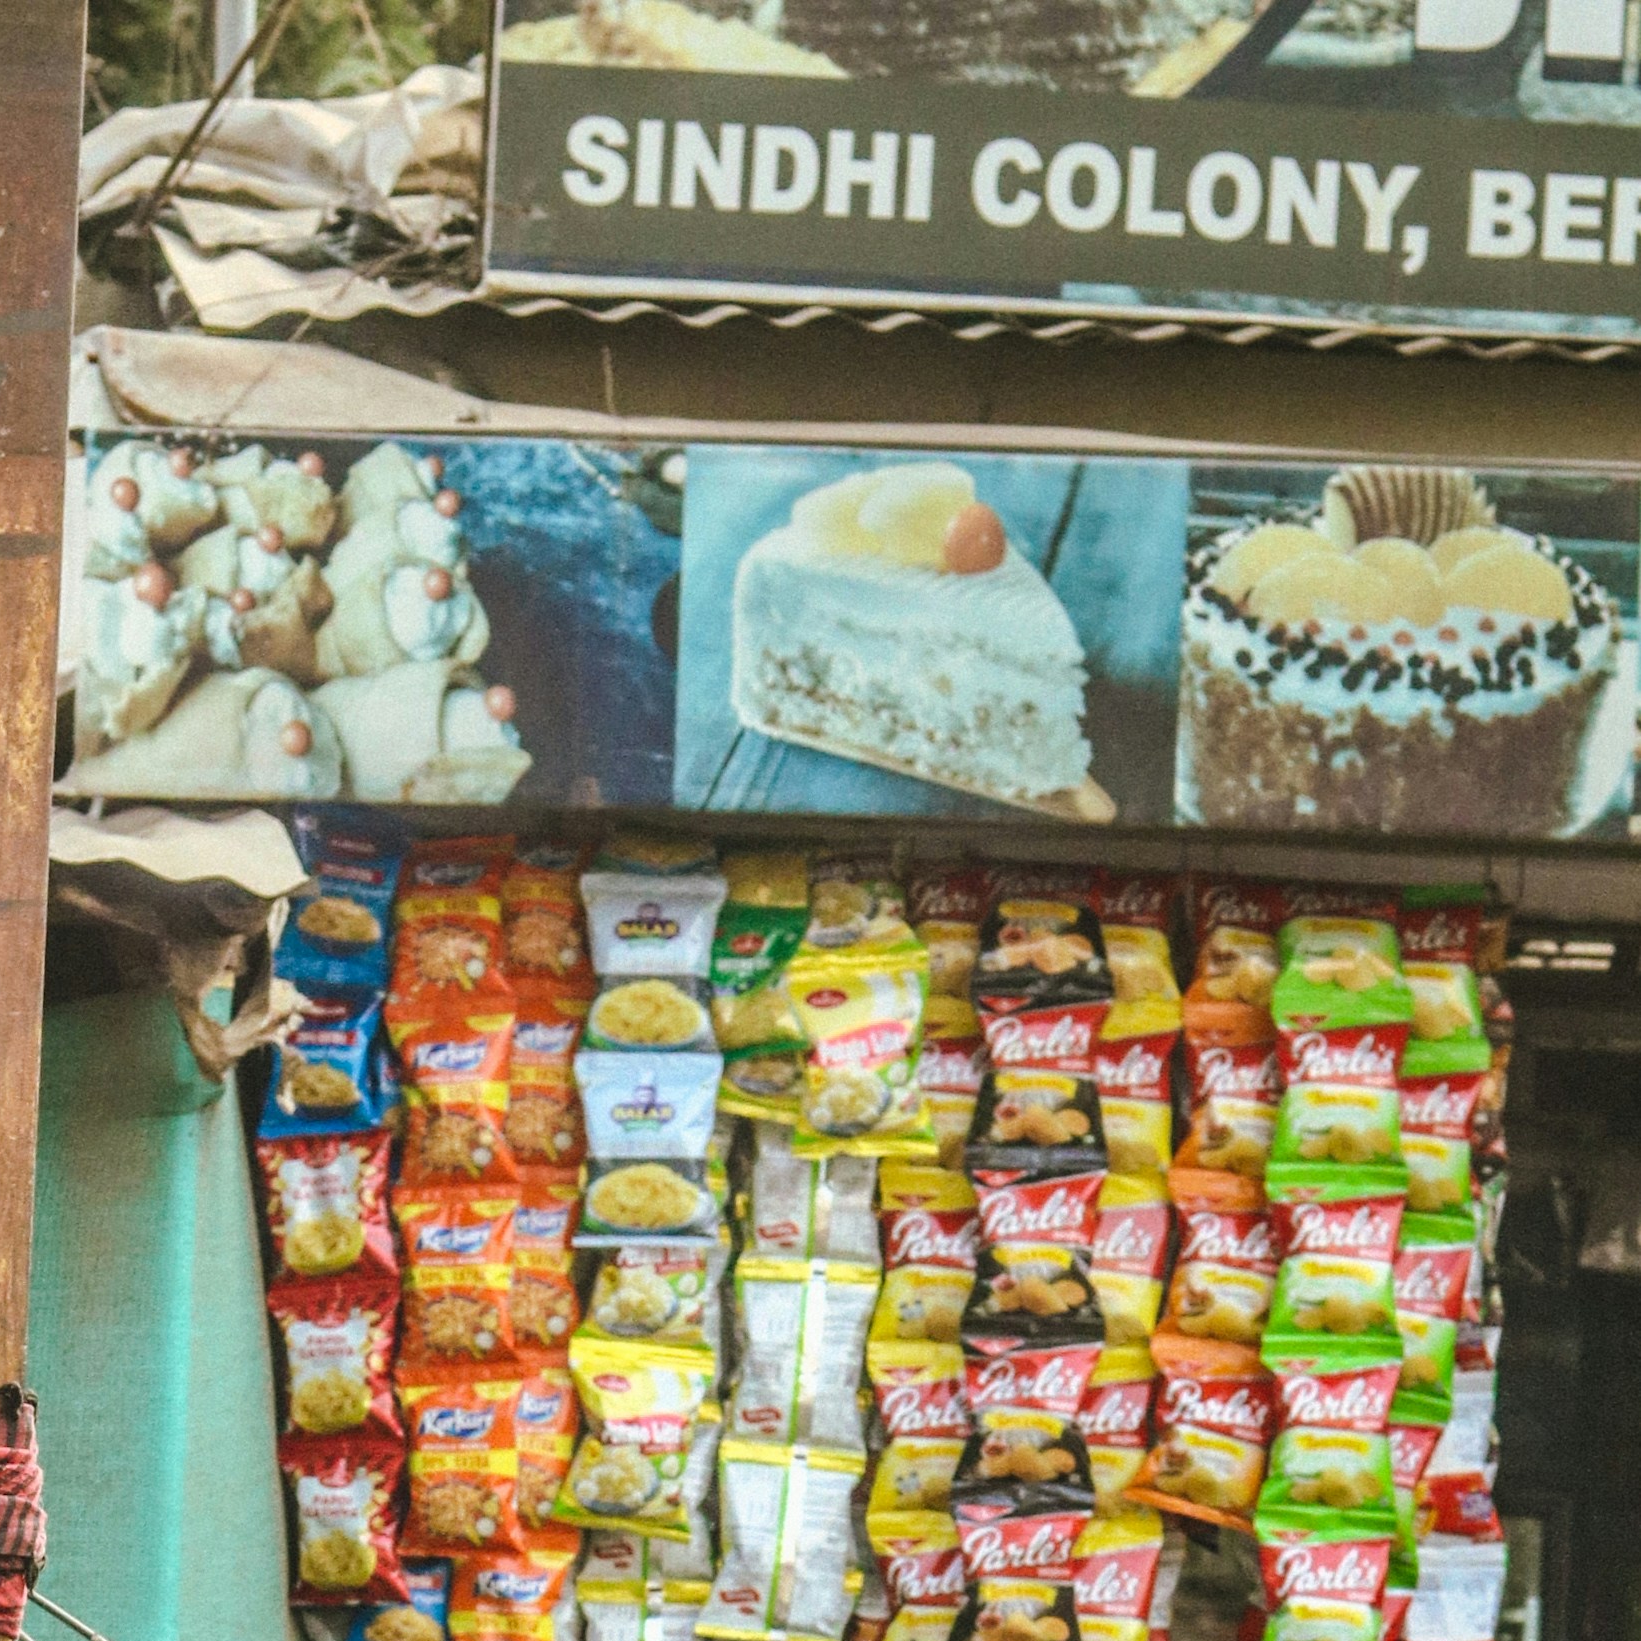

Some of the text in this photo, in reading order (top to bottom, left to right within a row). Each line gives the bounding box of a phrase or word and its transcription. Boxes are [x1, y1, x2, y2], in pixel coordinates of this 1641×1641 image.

[563, 115, 935, 222] SINDHI
[971, 137, 1429, 274] COLONY,
[985, 1015, 1092, 1062] Parle's
[1287, 1032, 1396, 1083] Parle's
[978, 1188, 1086, 1241] Parle's
[1288, 1202, 1390, 1251] Parle's
[970, 1356, 1083, 1404] Parle's
[1282, 1375, 1387, 1423] Parle's
[962, 1524, 1073, 1575] Parle's
[1275, 1546, 1379, 1598] Parle's
